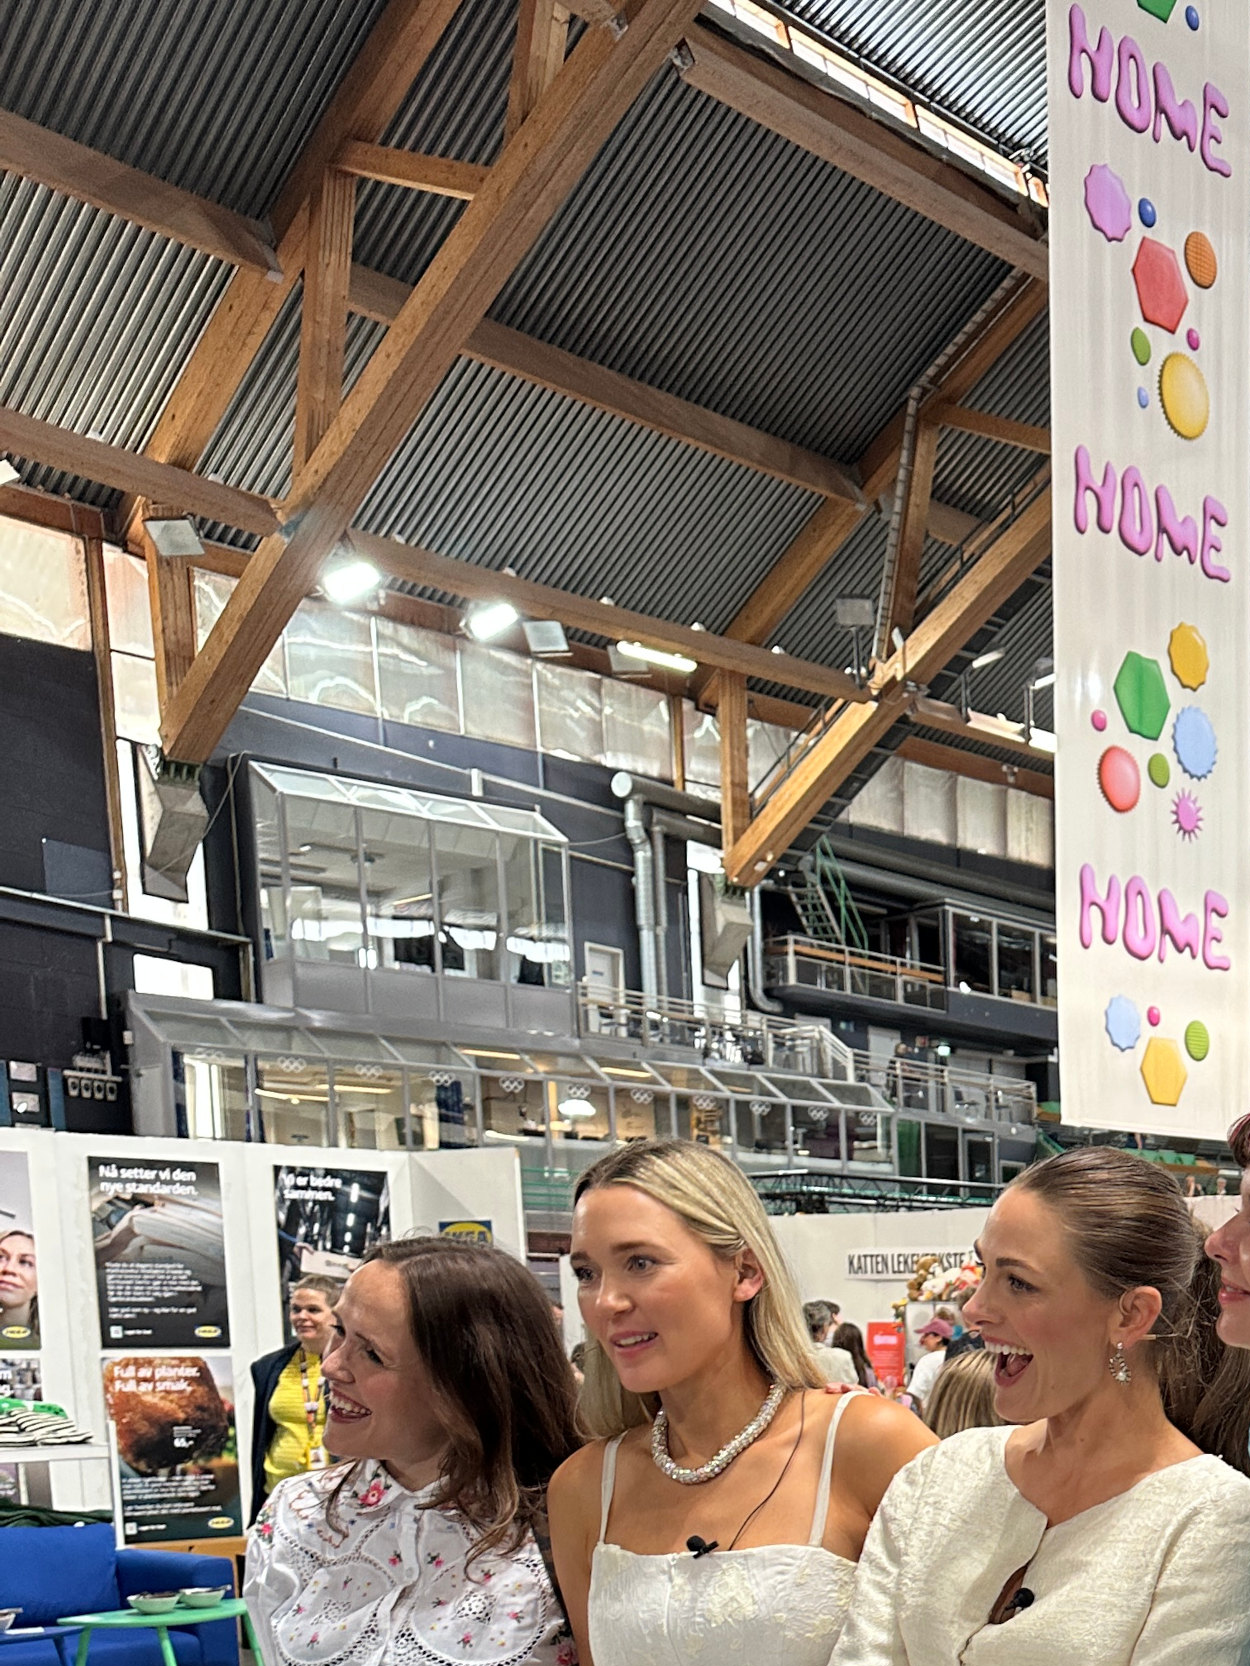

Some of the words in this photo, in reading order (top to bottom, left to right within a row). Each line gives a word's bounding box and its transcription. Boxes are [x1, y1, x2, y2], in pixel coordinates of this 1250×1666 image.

[1068, 3, 1231, 178] HOME
[1074, 444, 1231, 583] HOME
[1079, 863, 1231, 971] HOME
[98, 1164, 118, 1178] Nå
[120, 1167, 157, 1180] setter
[159, 1168, 171, 1180] vi
[172, 1168, 196, 1181] den
[100, 1182, 123, 1195] nye
[125, 1182, 199, 1195] standarden.
[297, 1176, 309, 1188] er
[310, 1174, 342, 1188] bedre
[284, 1188, 336, 1201] sammen.
[848, 1254, 889, 1275] KATTEN
[113, 1365, 136, 1378] Full
[137, 1367, 153, 1378] av
[154, 1366, 200, 1380] planter.
[114, 1379, 137, 1392] Full
[138, 1381, 154, 1392] av
[155, 1379, 193, 1393] smak.
